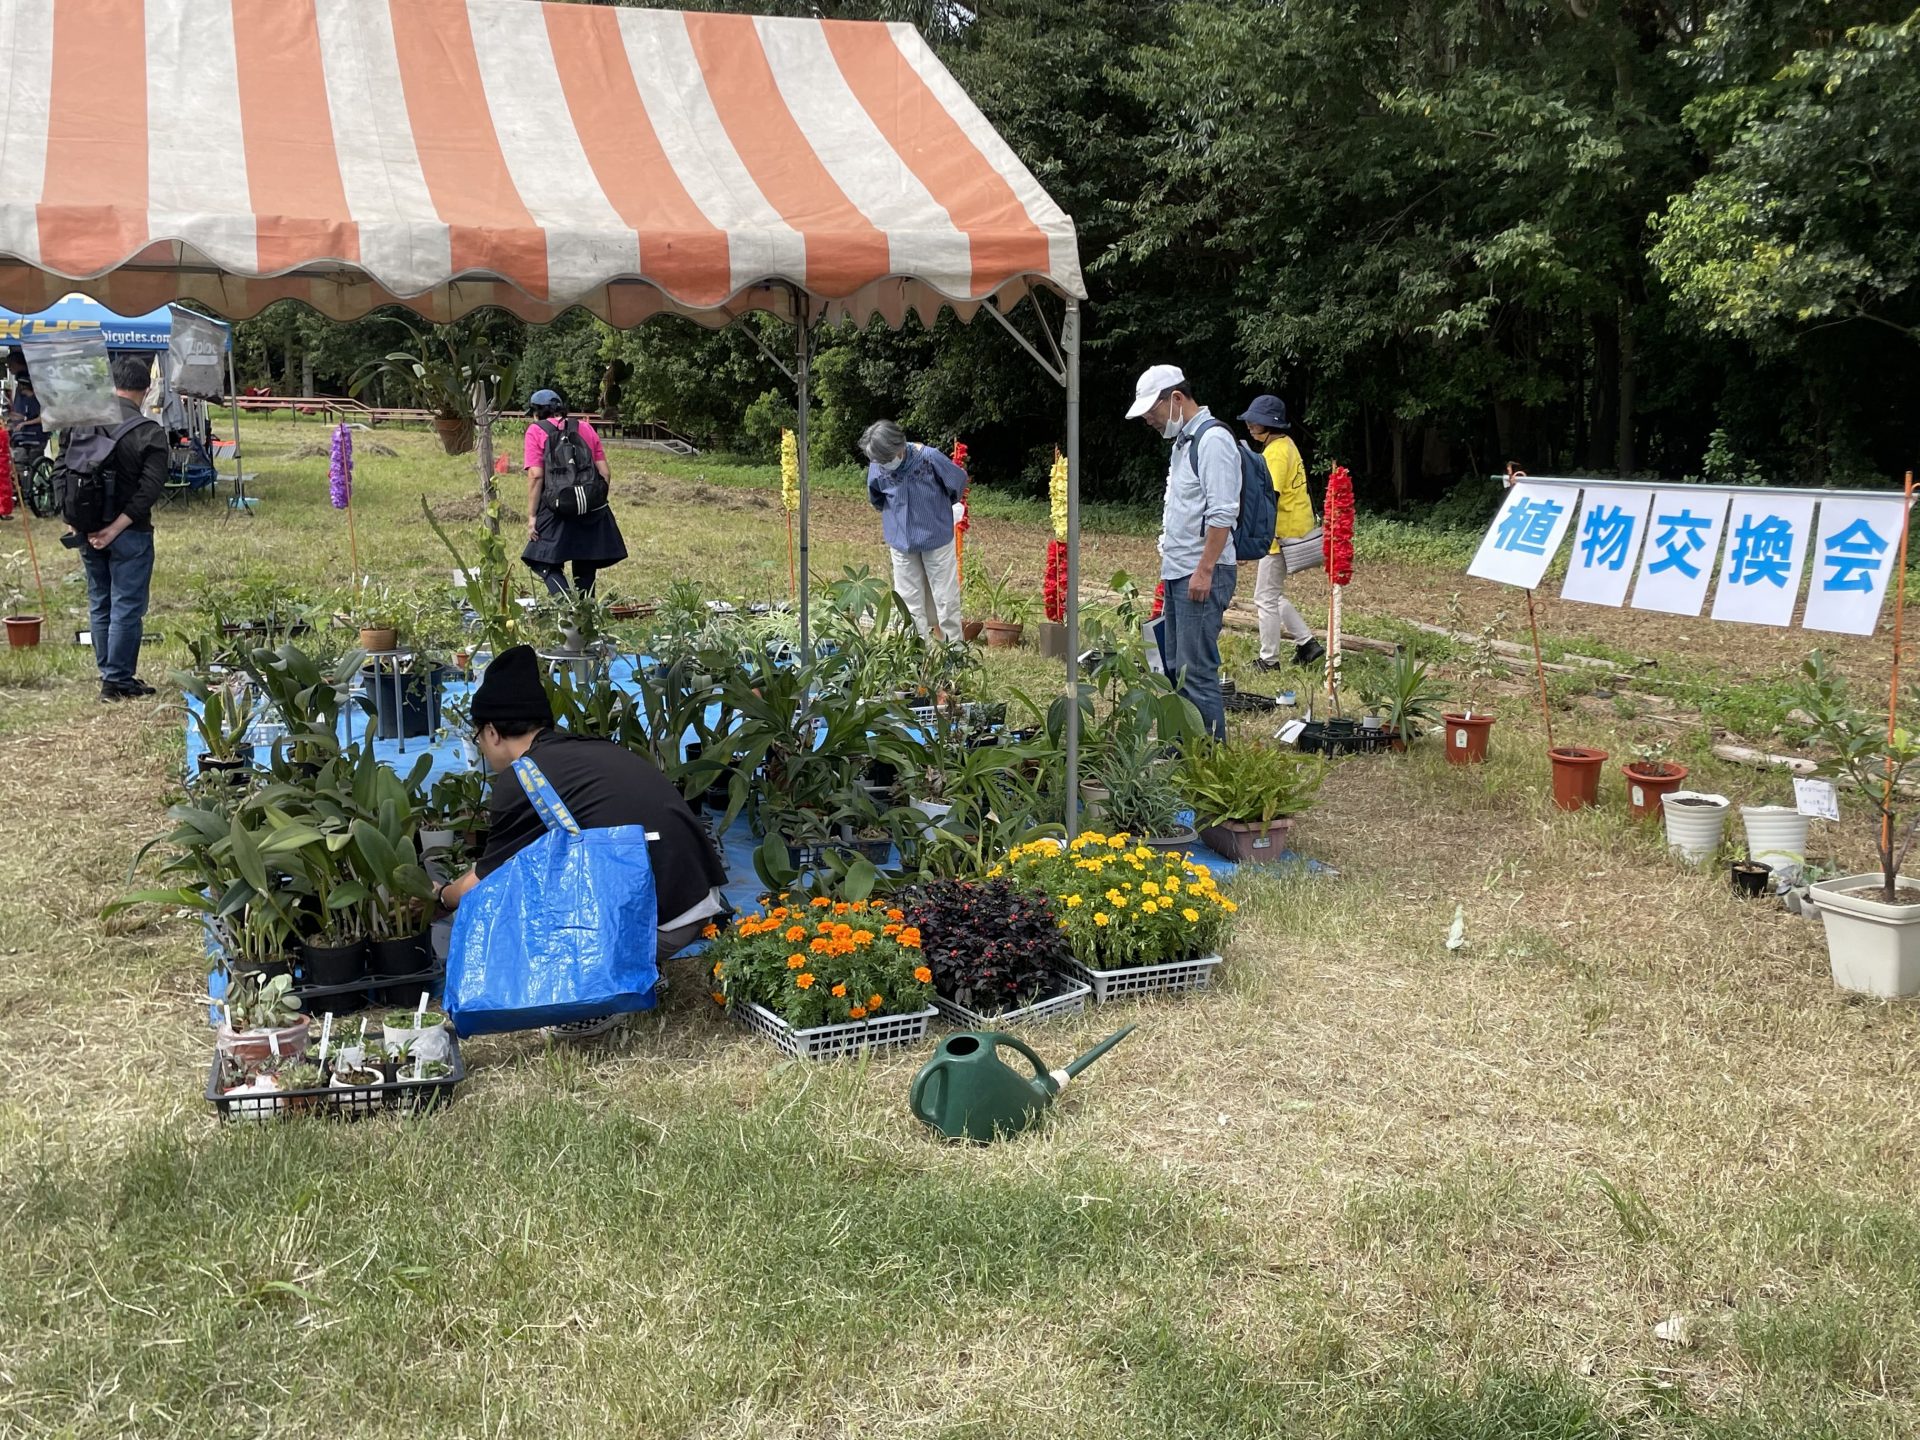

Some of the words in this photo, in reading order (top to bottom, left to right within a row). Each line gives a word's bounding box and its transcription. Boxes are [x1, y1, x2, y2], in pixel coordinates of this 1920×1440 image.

[1496, 497, 1889, 594] 植物交換会
